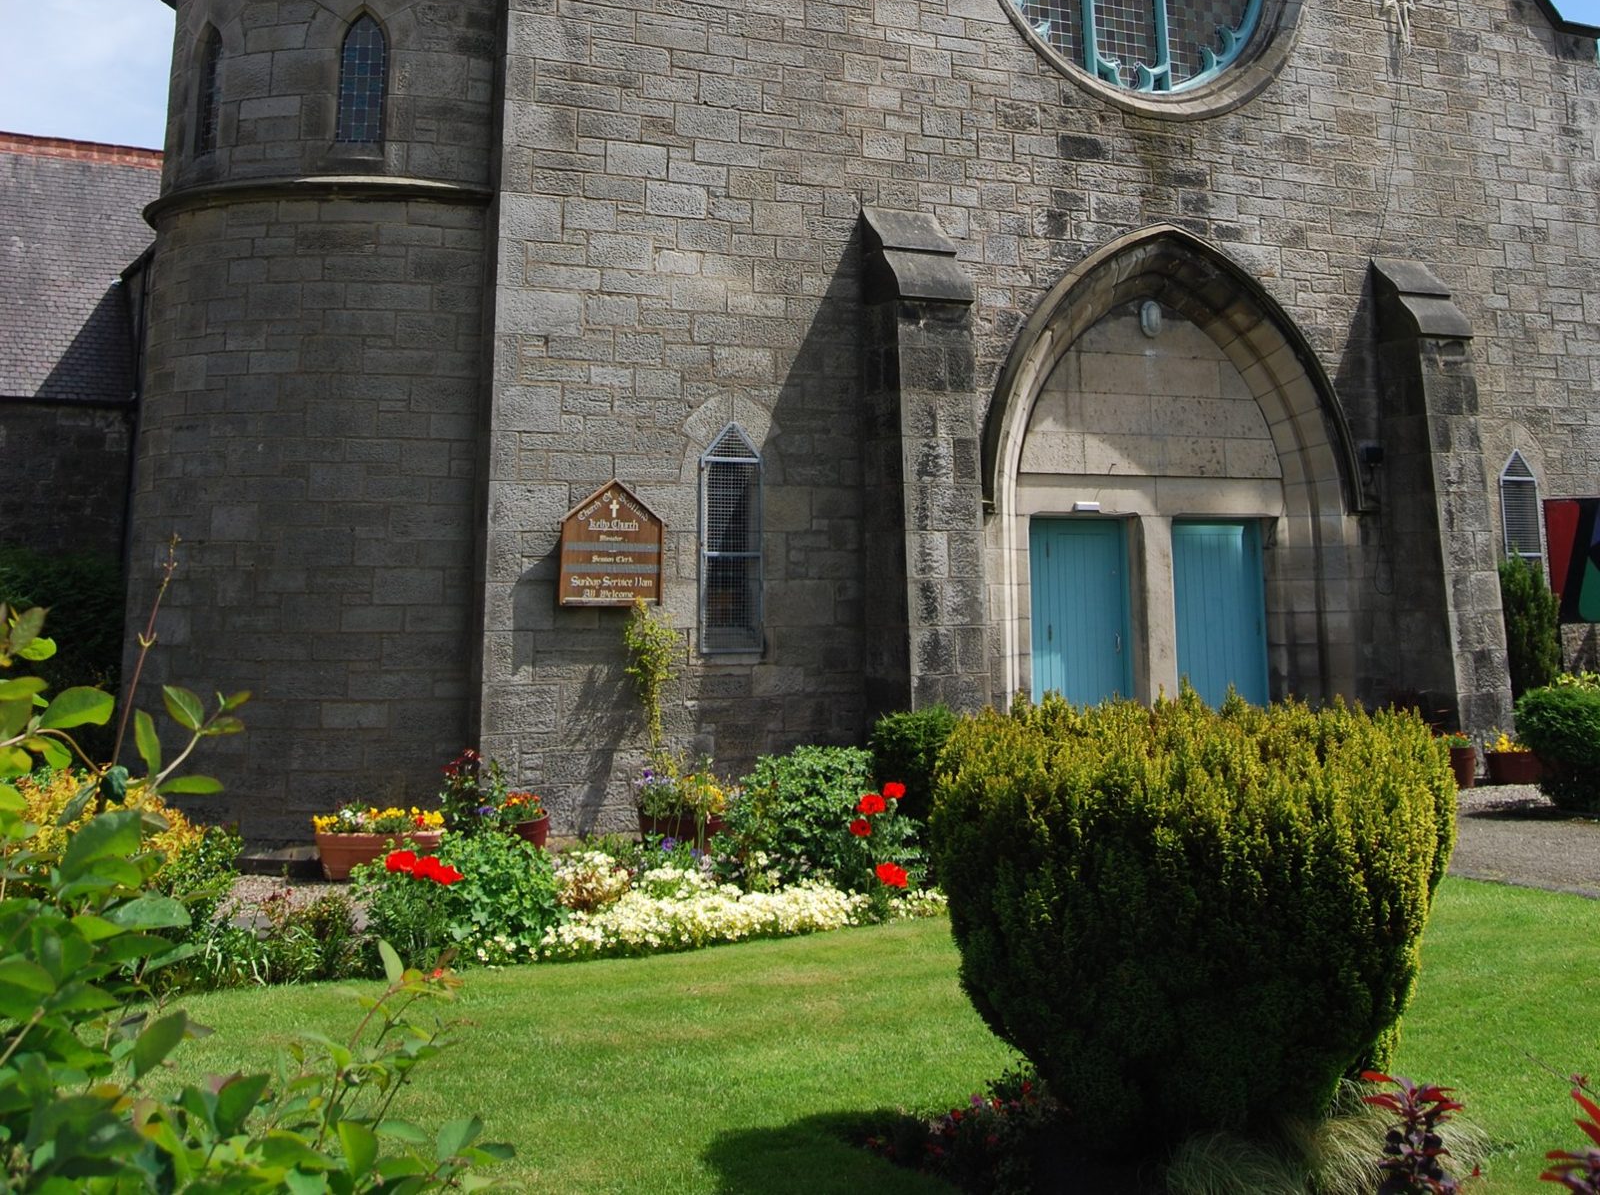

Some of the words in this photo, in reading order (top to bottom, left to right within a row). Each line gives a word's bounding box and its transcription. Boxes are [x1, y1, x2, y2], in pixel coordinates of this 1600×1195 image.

[577, 500, 602, 521] Church
[611, 519, 639, 530] Church
[570, 575, 601, 589] Sunday
[602, 575, 632, 587] Service
